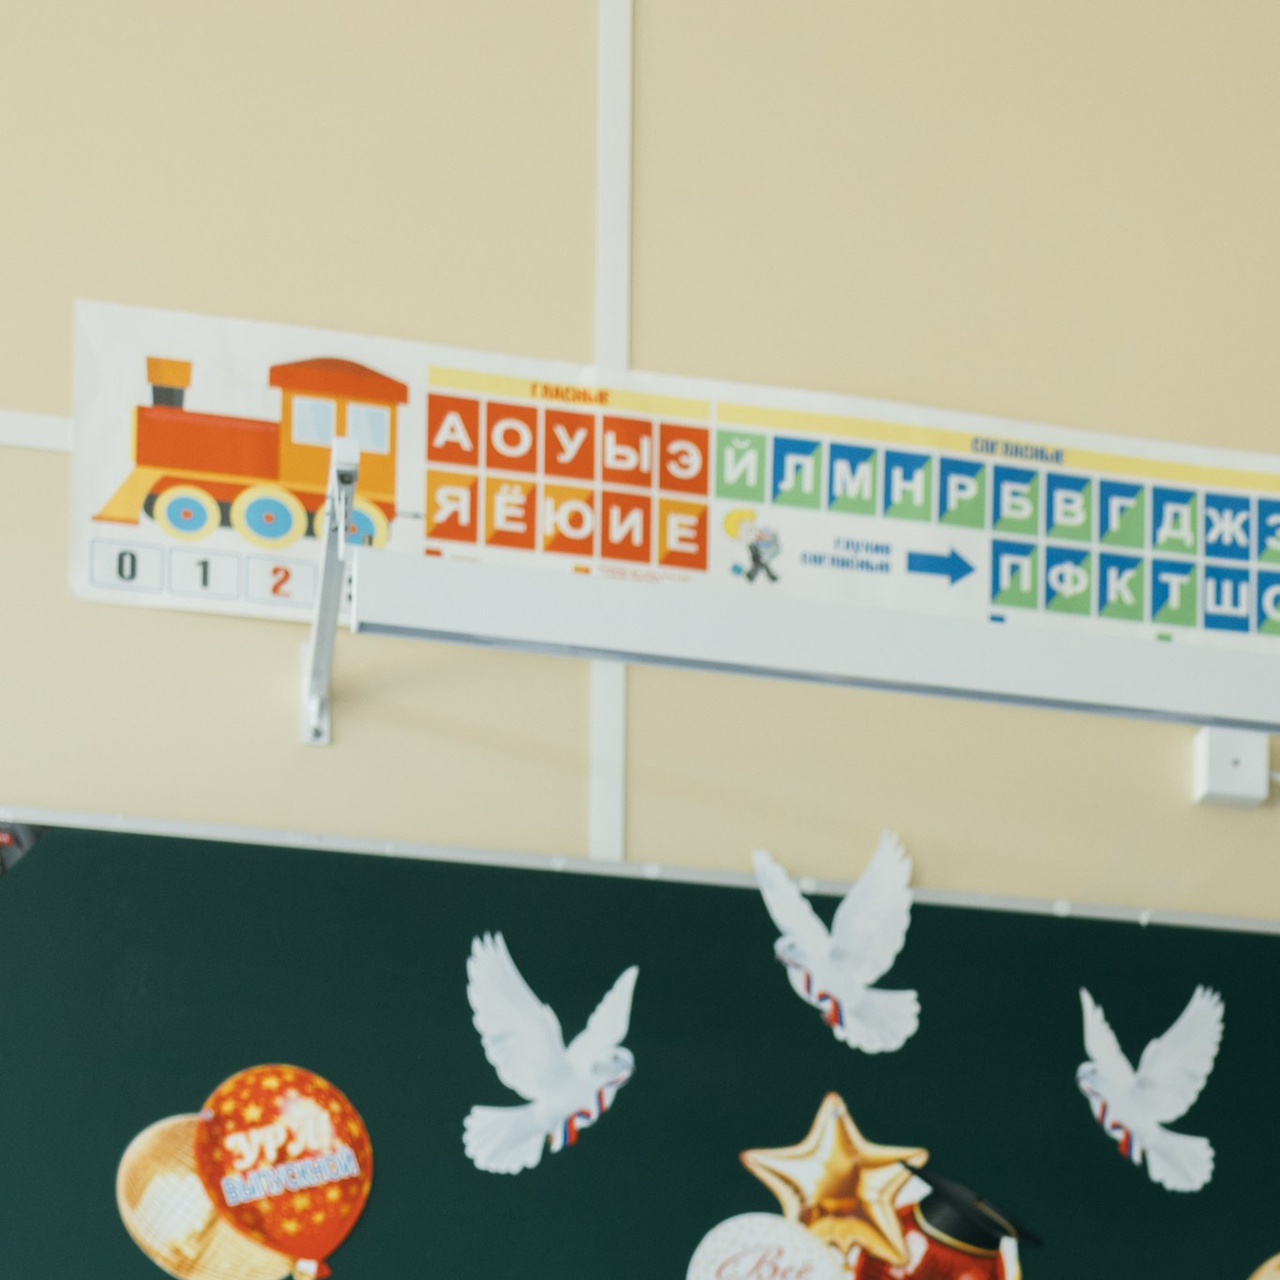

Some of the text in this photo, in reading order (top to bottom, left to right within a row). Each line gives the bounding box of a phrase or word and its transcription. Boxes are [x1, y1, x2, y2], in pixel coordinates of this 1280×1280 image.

[433, 411, 703, 479] А О У Ы Э
[433, 483, 699, 555] Я Ё Ю И Е
[724, 436, 758, 488] Й
[778, 454, 814, 494] Л
[833, 458, 872, 500] М
[891, 465, 924, 507] Н
[946, 473, 978, 511] Р
[1000, 479, 1034, 520] Б
[1053, 487, 1087, 527] В
[1108, 494, 1137, 533] Г
[1156, 501, 1194, 548] Д
[1205, 507, 1250, 547] Ж
[117, 551, 293, 599] 0 1 2
[1000, 553, 1031, 593] П
[1047, 560, 1089, 599] Ф
[1107, 566, 1136, 606] К
[1158, 571, 1191, 611] Т
[1206, 576, 1250, 619] Ш
